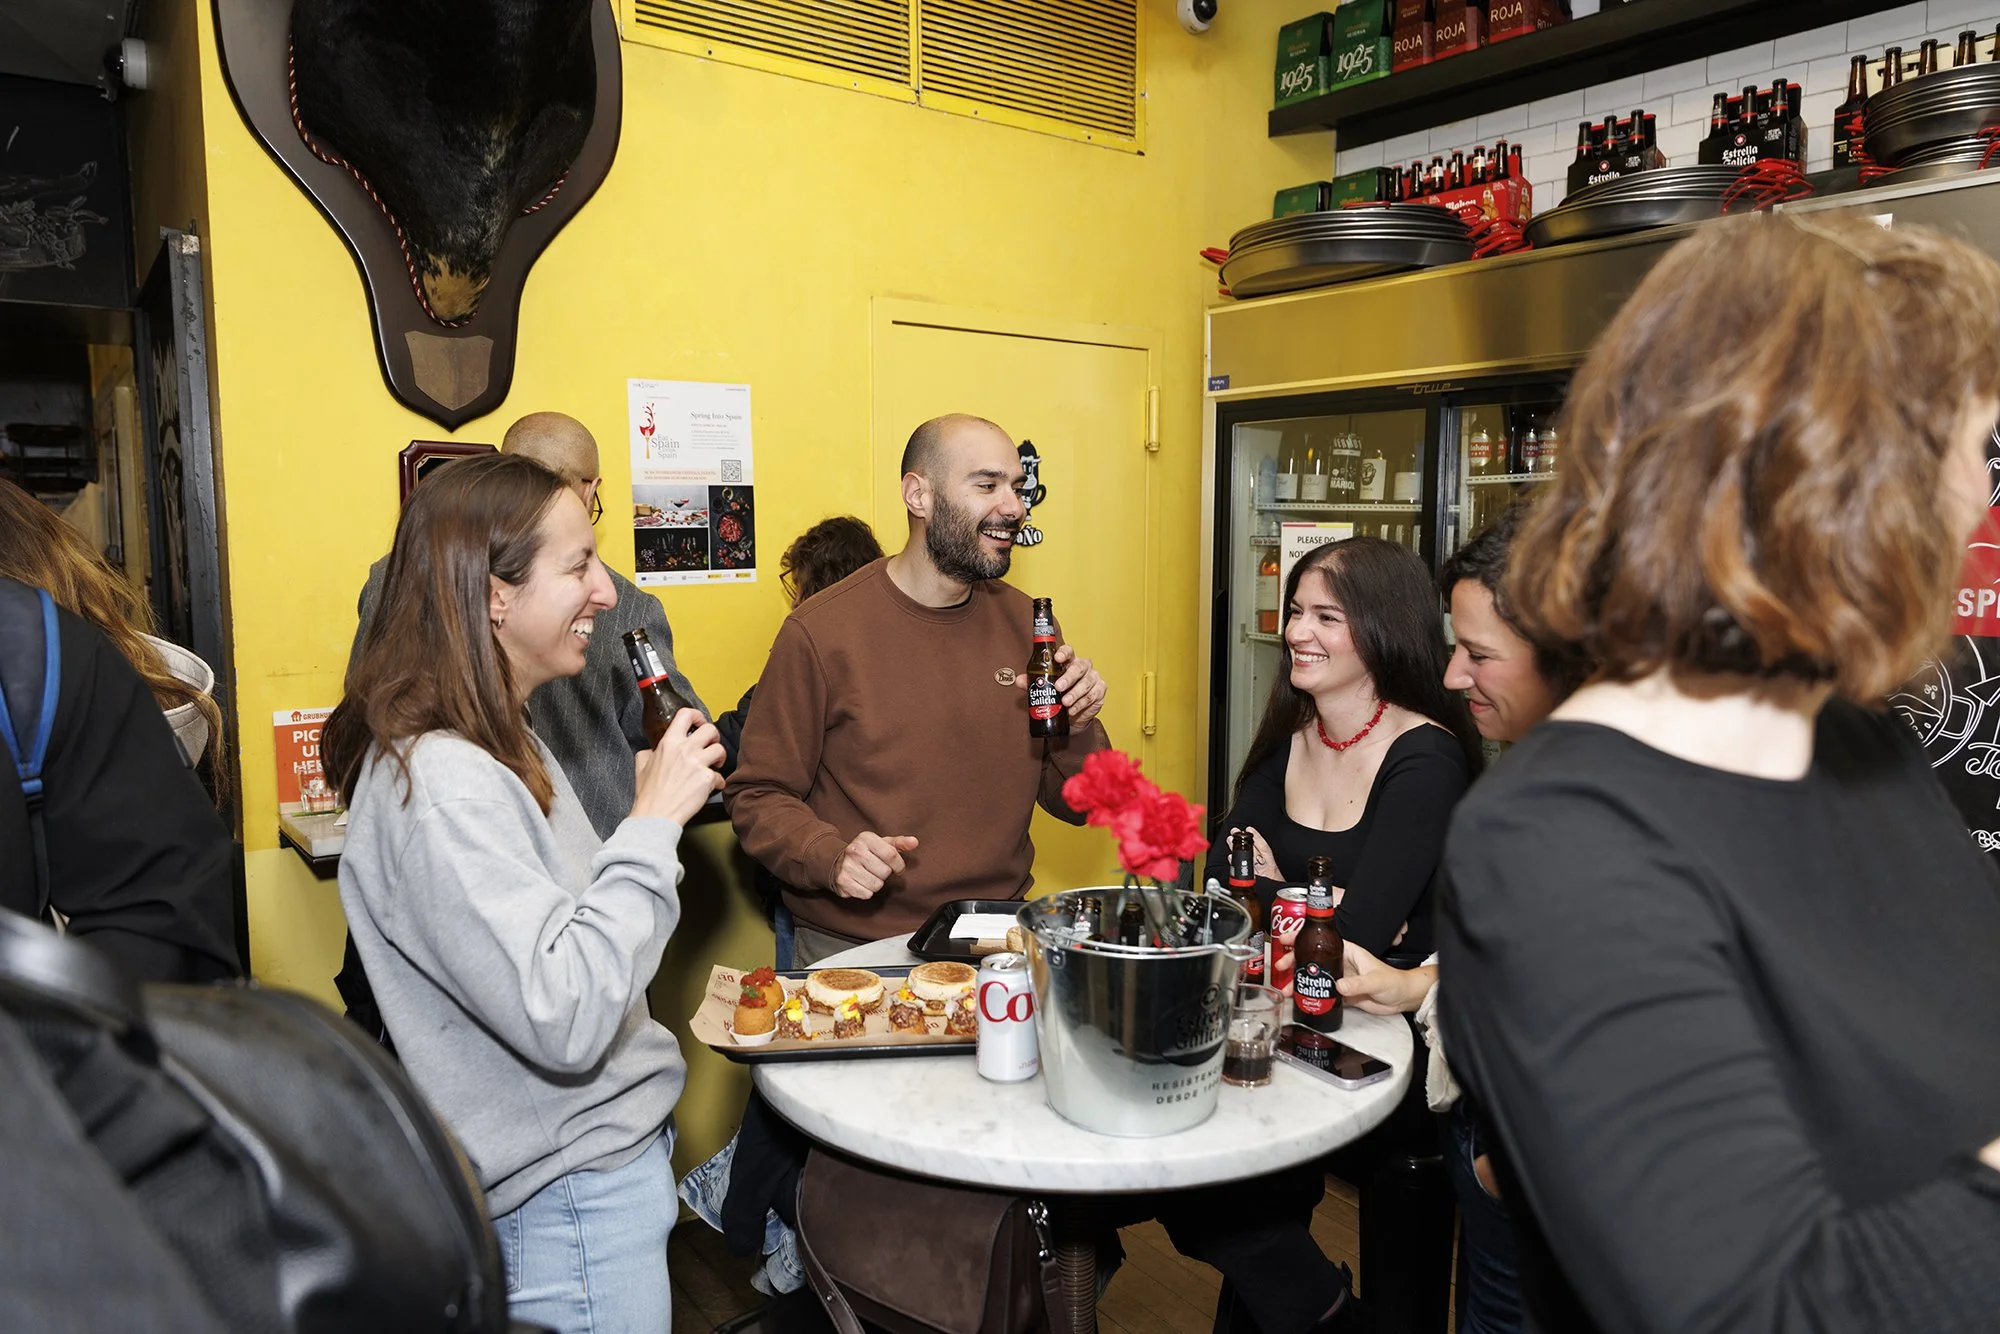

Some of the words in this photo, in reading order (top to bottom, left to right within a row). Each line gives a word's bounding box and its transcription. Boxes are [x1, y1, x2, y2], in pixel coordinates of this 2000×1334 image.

[1490, 1, 1523, 23] ROJA
[1436, 21, 1466, 43] ROJA
[1393, 34, 1423, 54] ROJA
[1336, 44, 1375, 80] 1925
[1280, 62, 1315, 97] 1925
[1722, 145, 1758, 159] Estrella
[1588, 171, 1621, 185] Estrella
[1445, 199, 1477, 211] Mahou
[650, 437, 680, 450] Spain
[1471, 443, 1490, 451] ahou
[1538, 442, 1558, 450] ahou
[1330, 480, 1356, 490] MARIOL
[1297, 536, 1323, 544] PLEASE
[1324, 536, 1336, 544] DO
[1289, 550, 1304, 558] NOT
[1957, 587, 2000, 618] SP
[1030, 688, 1057, 697] Estrella
[1031, 696, 1056, 706] Galicia
[293, 729, 322, 743] PIC
[293, 760, 323, 774] HER
[1297, 973, 1332, 988] Estrella
[1297, 983, 1330, 998] Galicia
[1156, 1089, 1198, 1105] DESDE
